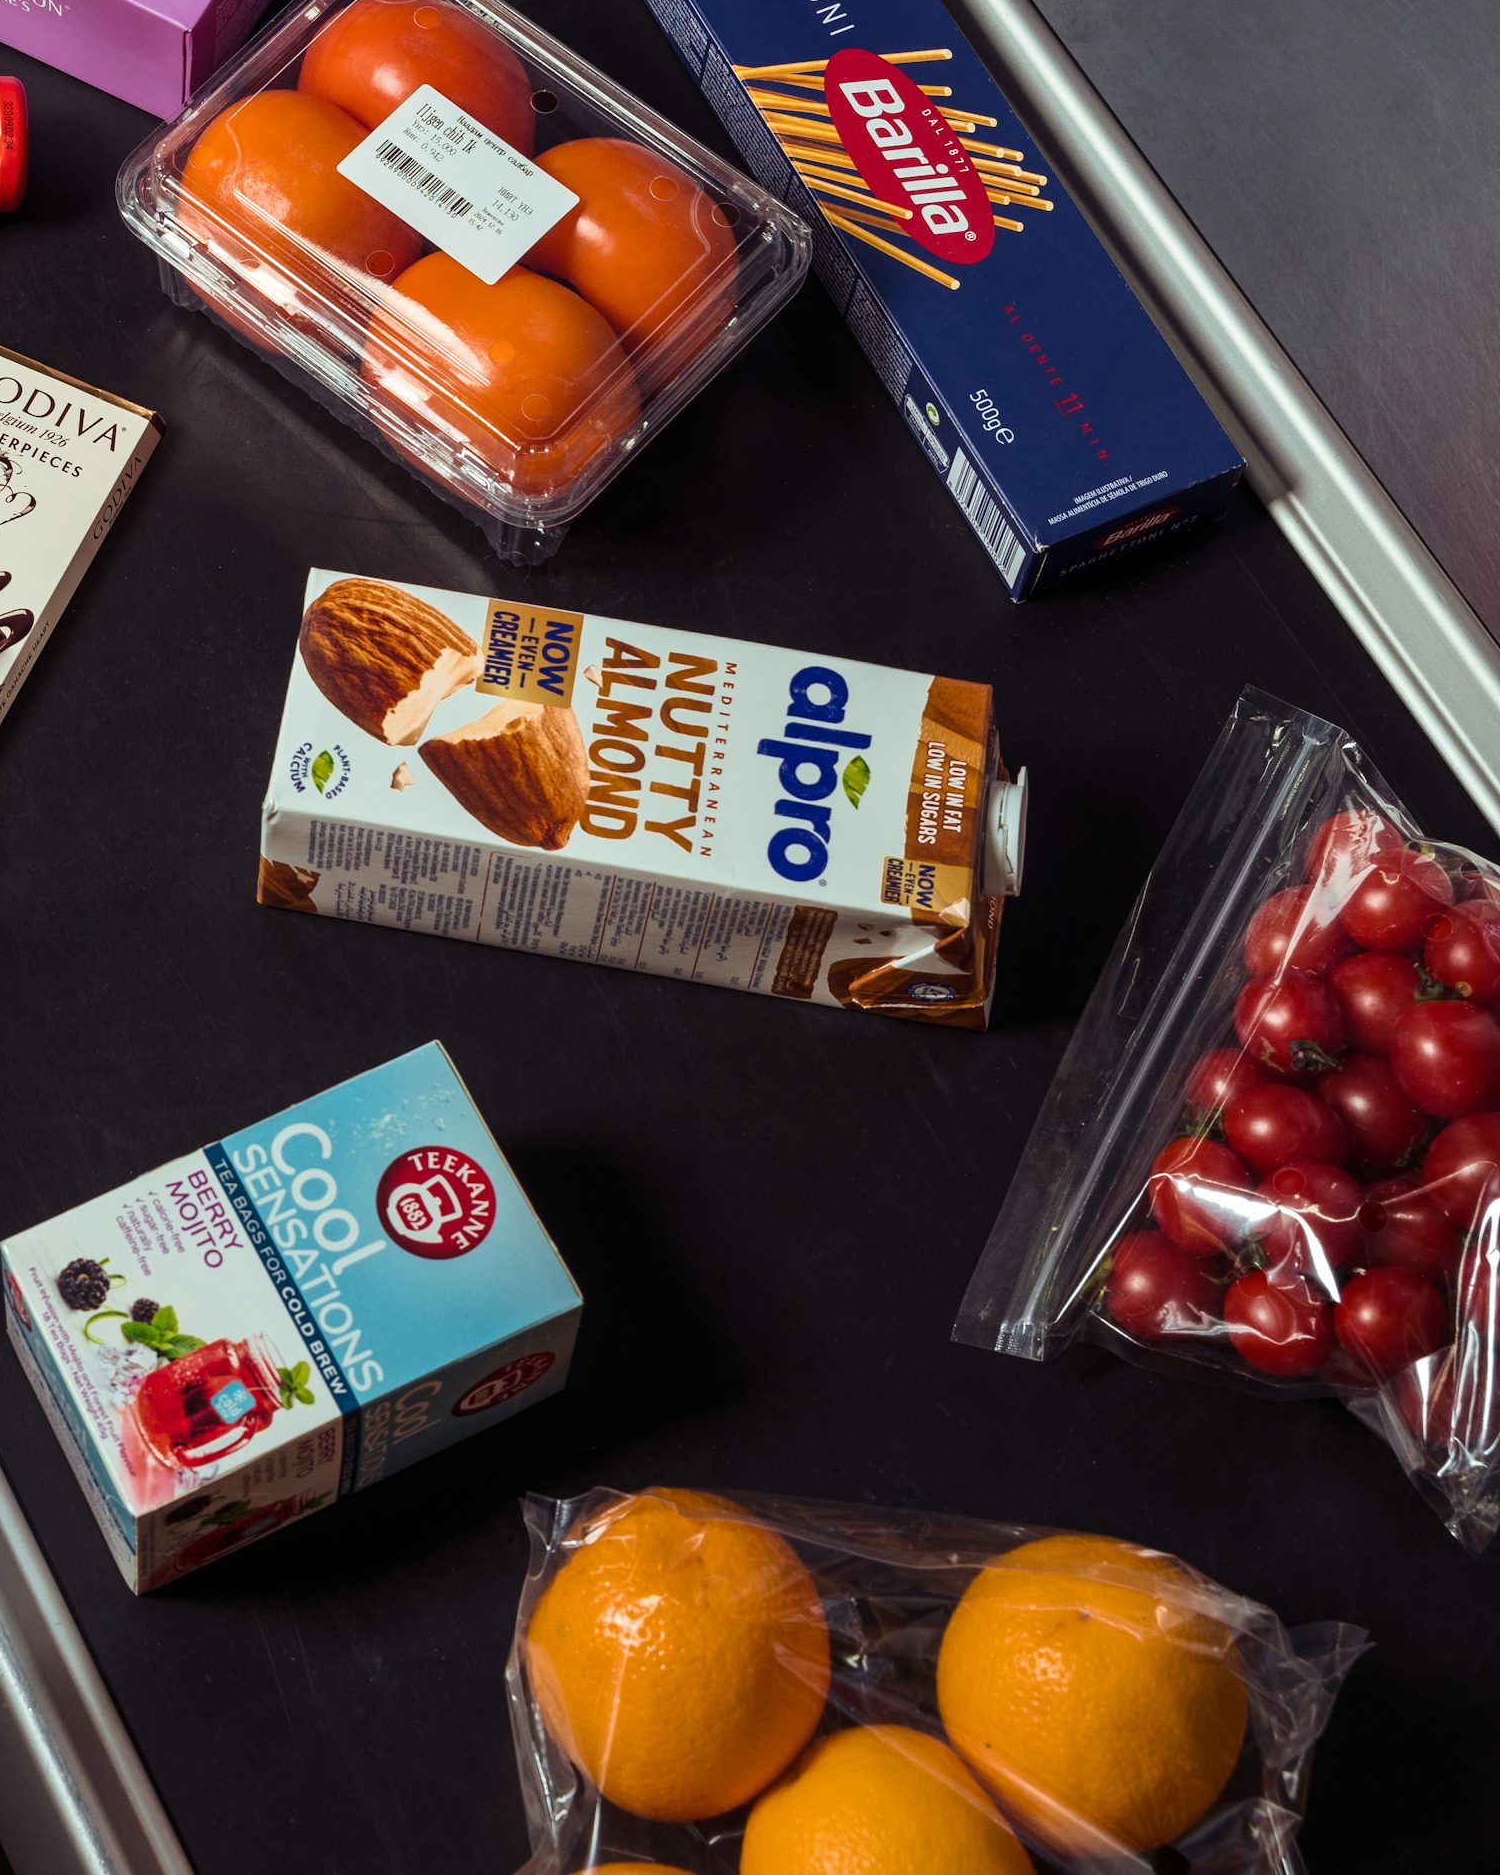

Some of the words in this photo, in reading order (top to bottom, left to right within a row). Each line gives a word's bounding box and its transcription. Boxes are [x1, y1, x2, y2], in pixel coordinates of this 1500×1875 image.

[838, 78, 969, 235] Barilla
[921, 108, 945, 135] DAL
[943, 140, 970, 173] 1877
[38, 427, 71, 449] 1926
[92, 454, 143, 541] GODIVA
[30, 621, 52, 658] HEART
[482, 610, 521, 686] CREAMIER
[517, 635, 540, 672] EVEN
[537, 620, 575, 696] NOW
[579, 636, 661, 840] ALMOND
[644, 651, 719, 854] NUTTY
[700, 662, 739, 857] MEDITERRANEAN
[926, 740, 947, 773] LOW
[289, 741, 313, 794] CALCIUM
[325, 744, 352, 801] PLANT-BASED
[757, 665, 872, 883] alpro
[923, 772, 943, 791] IN
[949, 759, 968, 791] LOW
[917, 789, 942, 846] SUGARS
[942, 806, 963, 834] FAT
[946, 790, 965, 808] IN
[884, 858, 904, 904] CREAMIER
[903, 872, 915, 895] EVEN
[915, 864, 936, 909] NOW
[152, 1198, 186, 1254] calorie-free
[165, 1180, 223, 1268] MOJITO
[187, 1169, 244, 1249] BERRY
[270, 1122, 387, 1276] Cool
[399, 1197, 427, 1230] 1882
[407, 1151, 490, 1250] TEEKANNE
[139, 1204, 170, 1255] sugar-free
[213, 1158, 239, 1195] TEA
[232, 1195, 267, 1245] BAGS
[260, 1245, 288, 1285] FOR
[281, 1285, 315, 1338] COLD
[309, 1341, 348, 1396] BREW
[232, 1143, 385, 1393] SENSATIONS
[28, 1266, 44, 1293] Fruit
[57, 1322, 71, 1342] with
